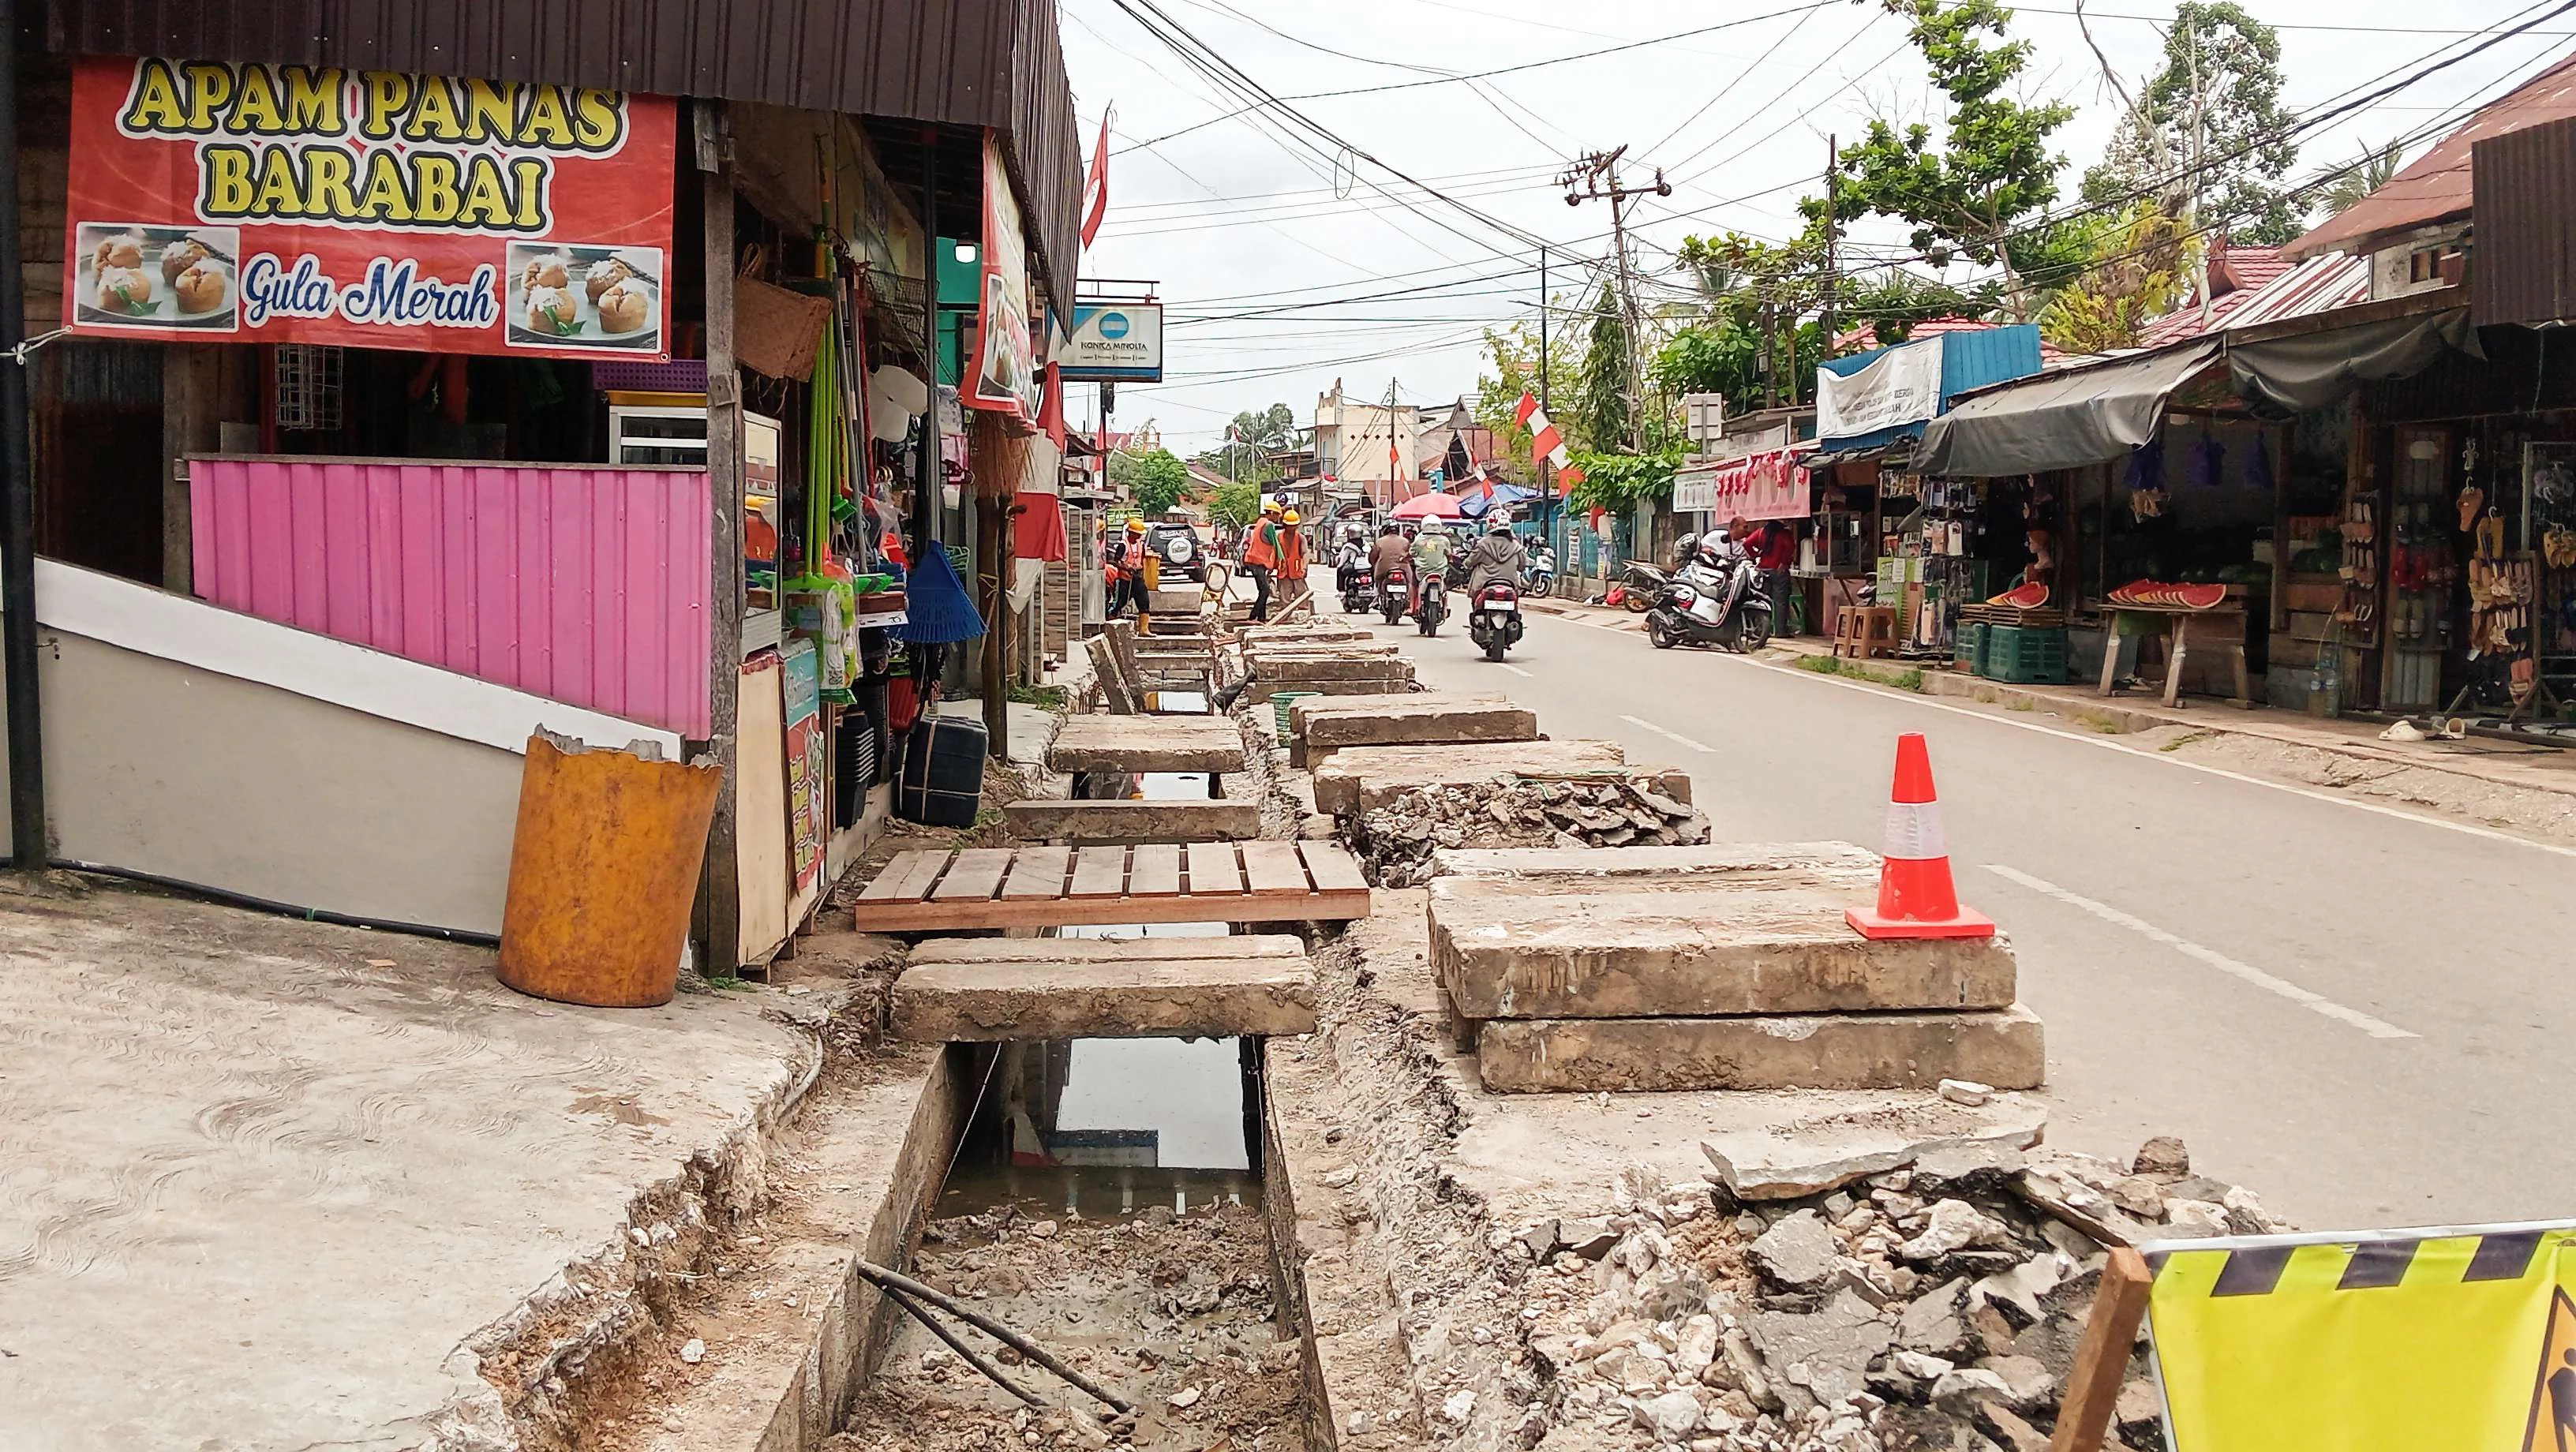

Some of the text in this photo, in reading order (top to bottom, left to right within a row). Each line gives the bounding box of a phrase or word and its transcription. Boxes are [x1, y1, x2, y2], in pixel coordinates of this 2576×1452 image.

[126, 60, 621, 152] APAM PANAS
[204, 145, 546, 230] BARABAI
[245, 259, 493, 322] Gula Merah
[1080, 341, 1148, 352] KONICA MINOLTA
